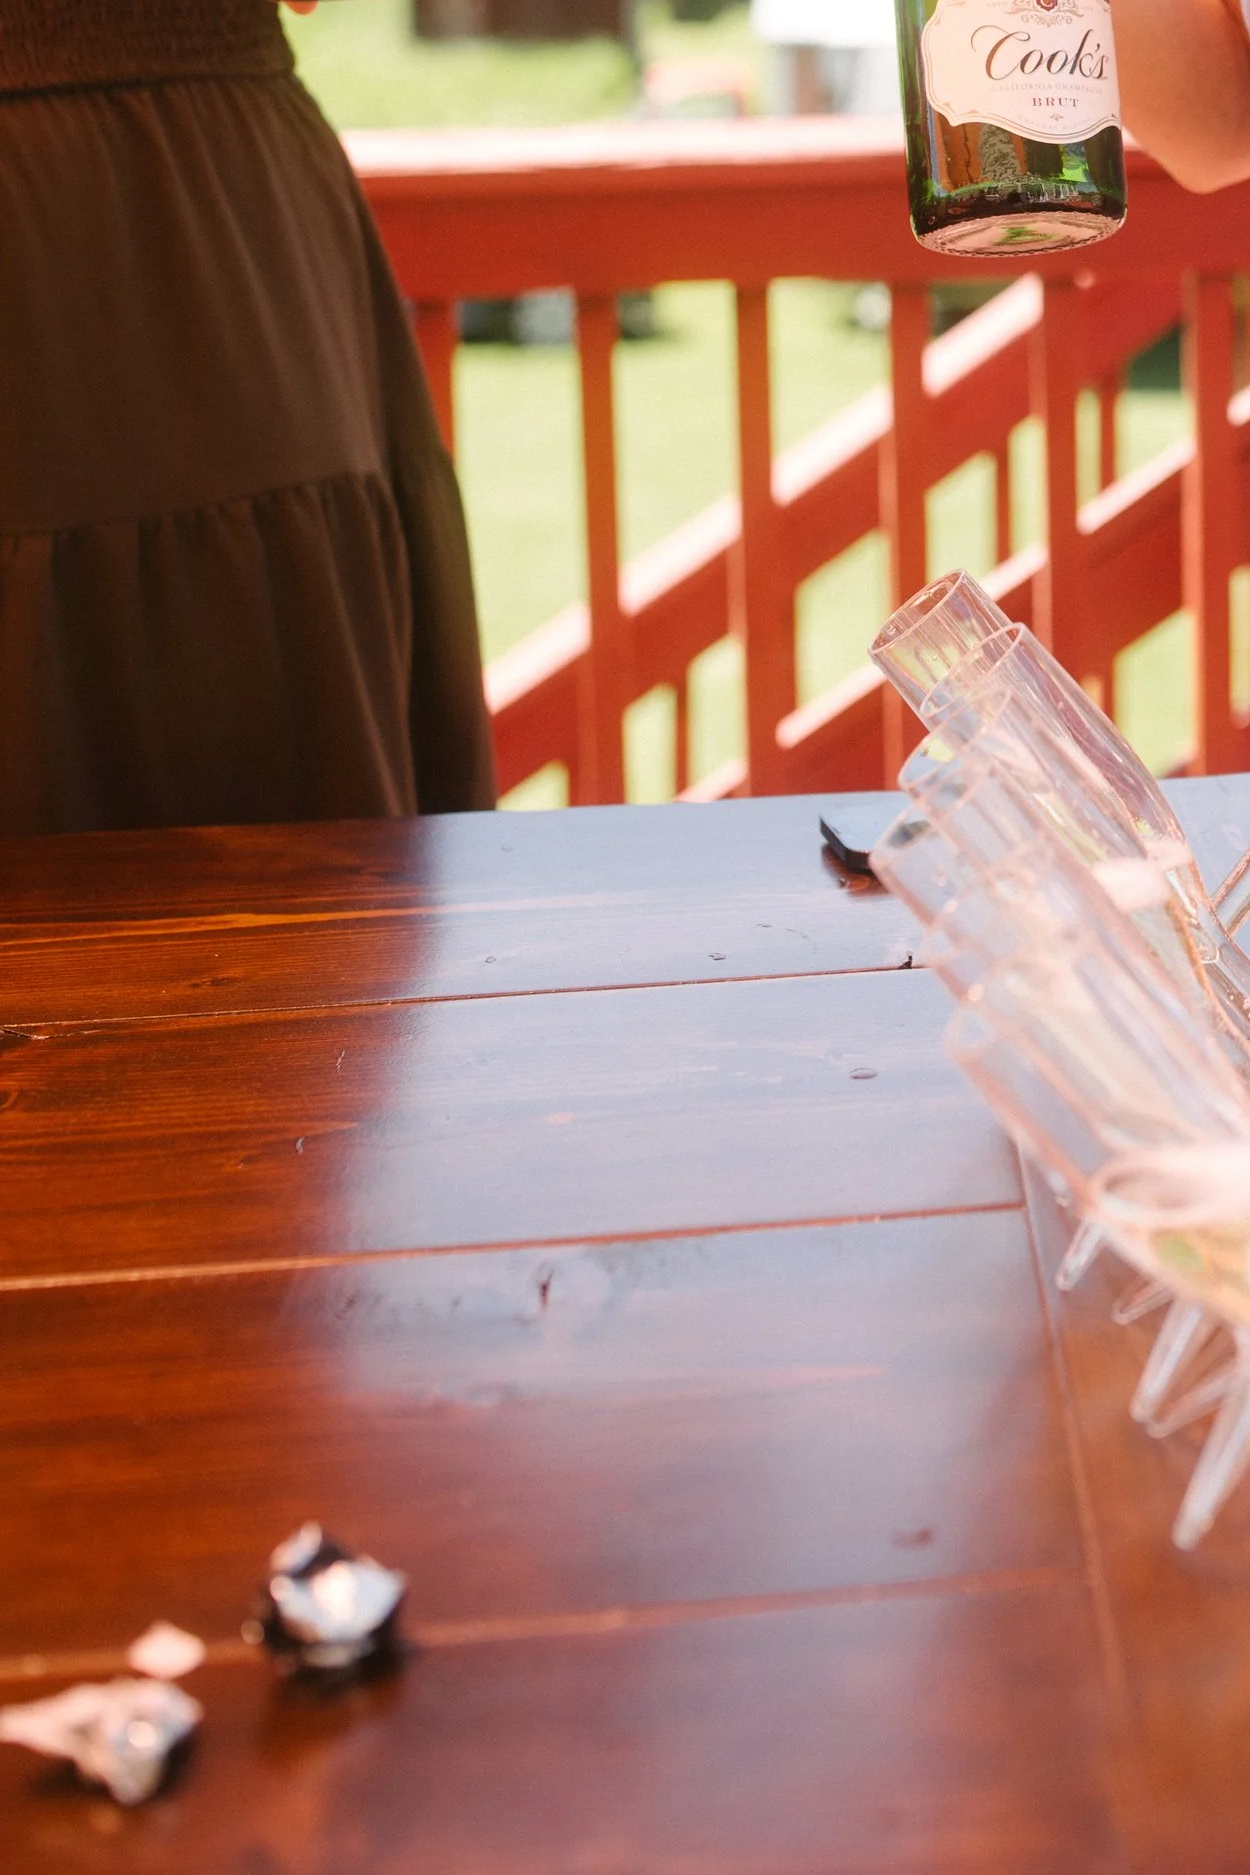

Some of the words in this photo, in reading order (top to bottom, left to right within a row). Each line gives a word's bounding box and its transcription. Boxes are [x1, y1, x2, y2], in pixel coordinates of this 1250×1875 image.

[971, 25, 1108, 80] Cook's
[991, 82, 1052, 93] CALIFORNIA
[1032, 97, 1079, 108] BRUT
